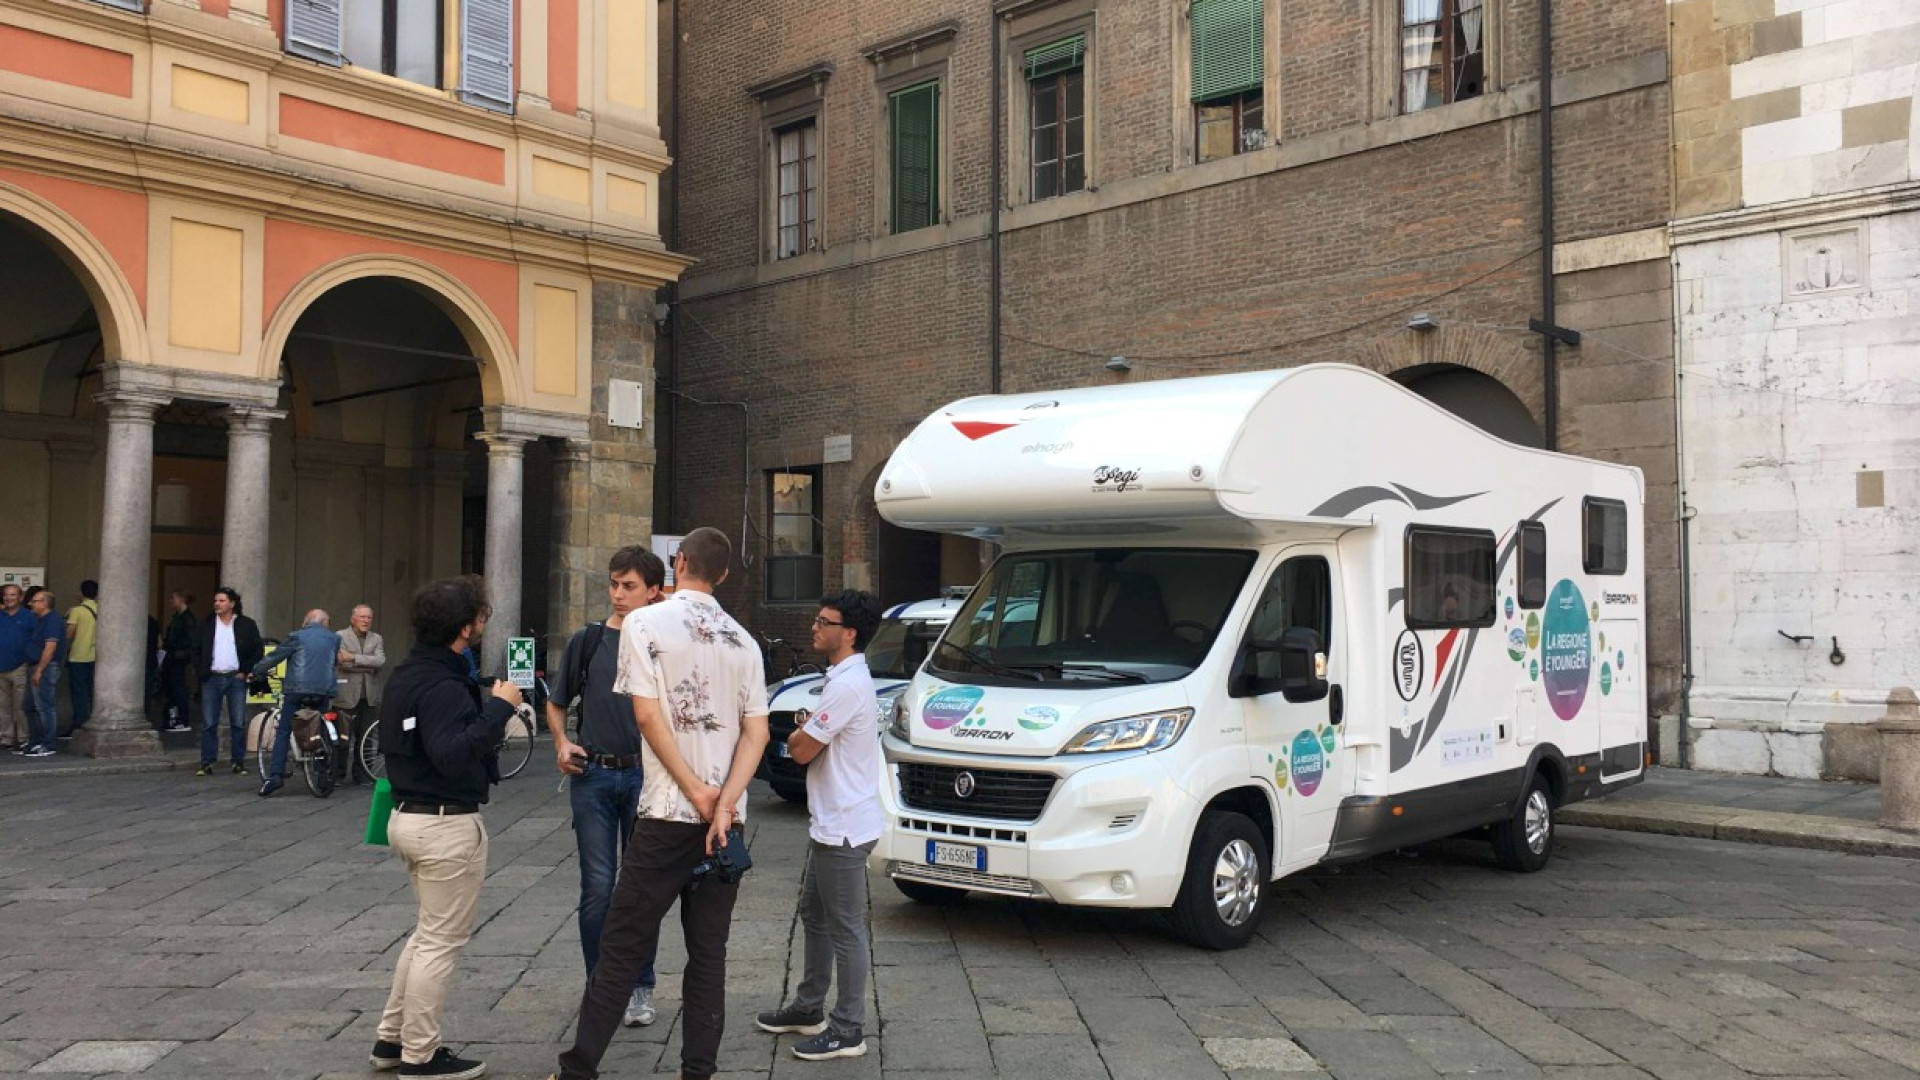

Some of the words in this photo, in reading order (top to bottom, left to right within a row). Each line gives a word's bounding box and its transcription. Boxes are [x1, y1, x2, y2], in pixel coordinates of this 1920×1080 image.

[1556, 632, 1588, 649] REGIONE
[955, 728, 1014, 740] BARON
[1301, 753, 1321, 763] REGIONE
